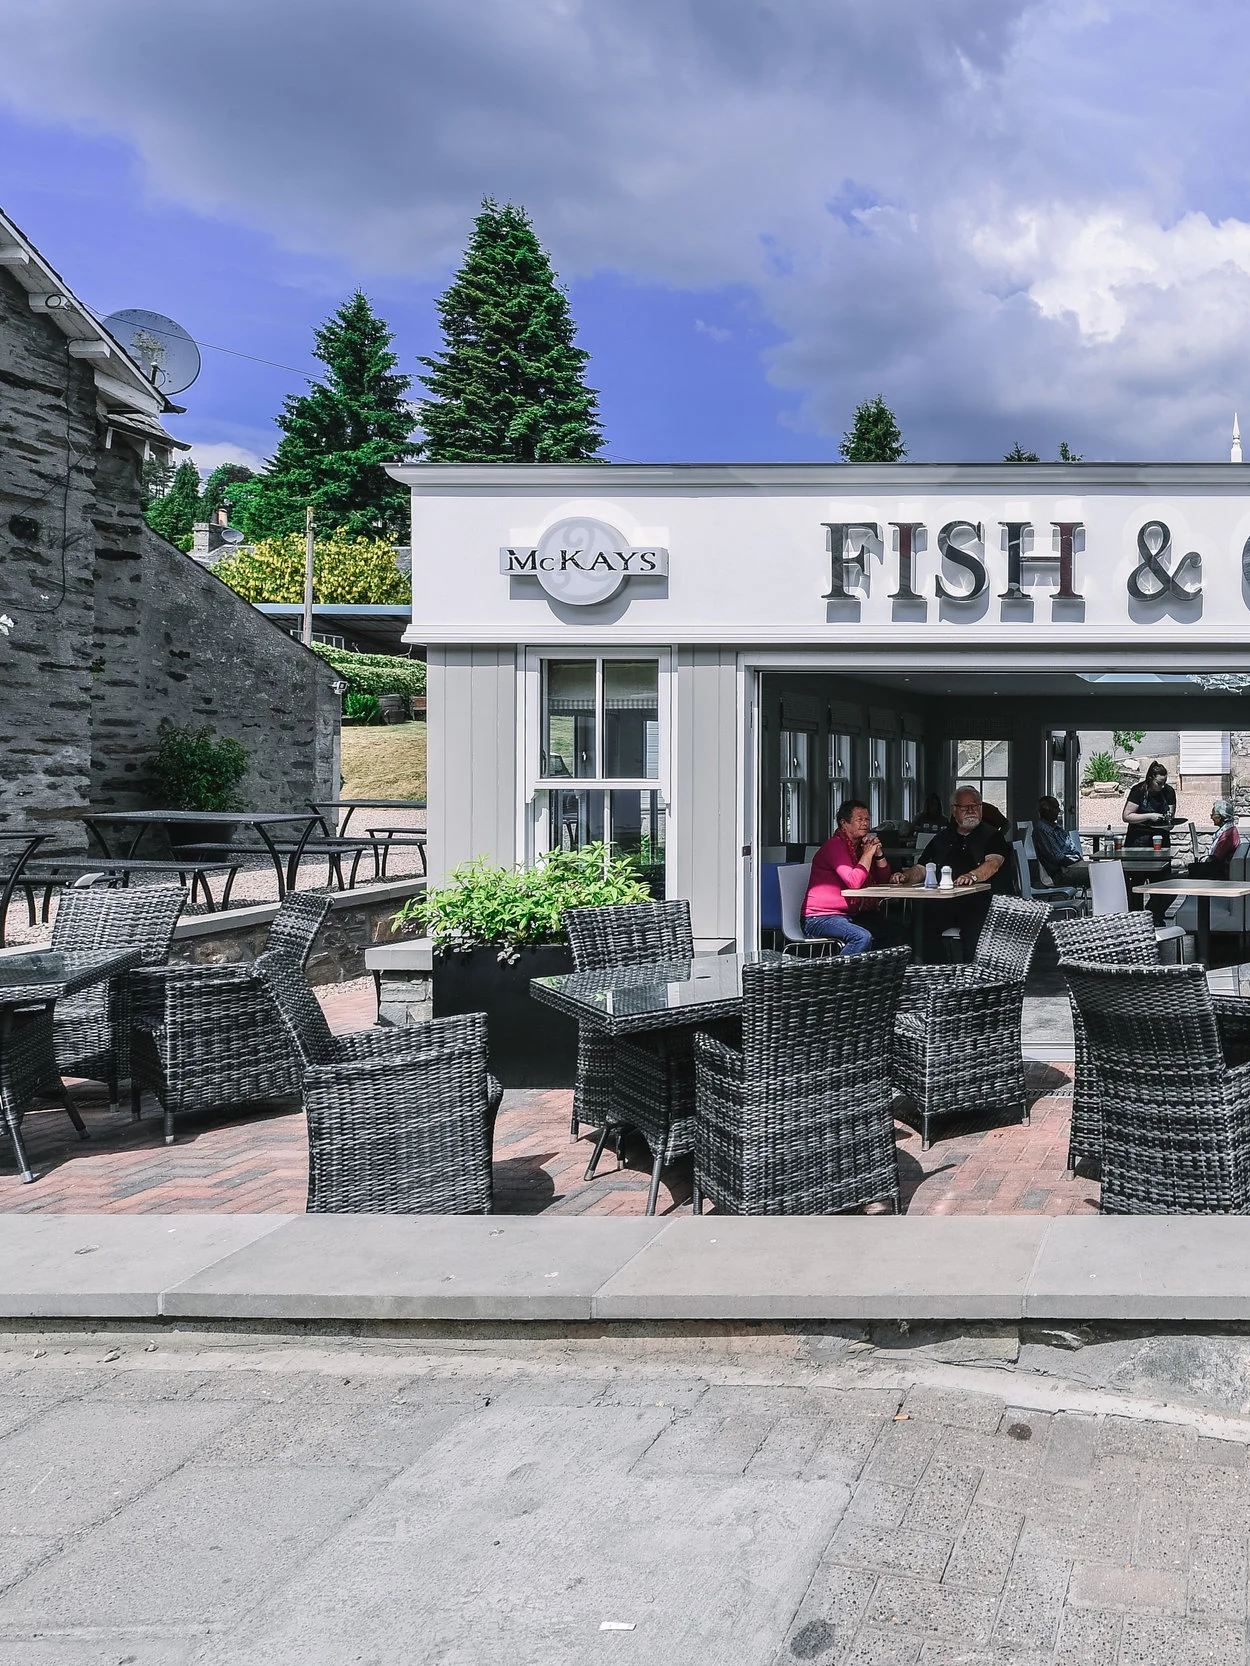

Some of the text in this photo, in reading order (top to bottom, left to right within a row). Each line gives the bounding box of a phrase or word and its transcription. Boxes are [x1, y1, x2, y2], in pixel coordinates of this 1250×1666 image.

[504, 549, 657, 571] McKAYS
[820, 520, 1086, 601] FISH
[1126, 520, 1204, 602] &
